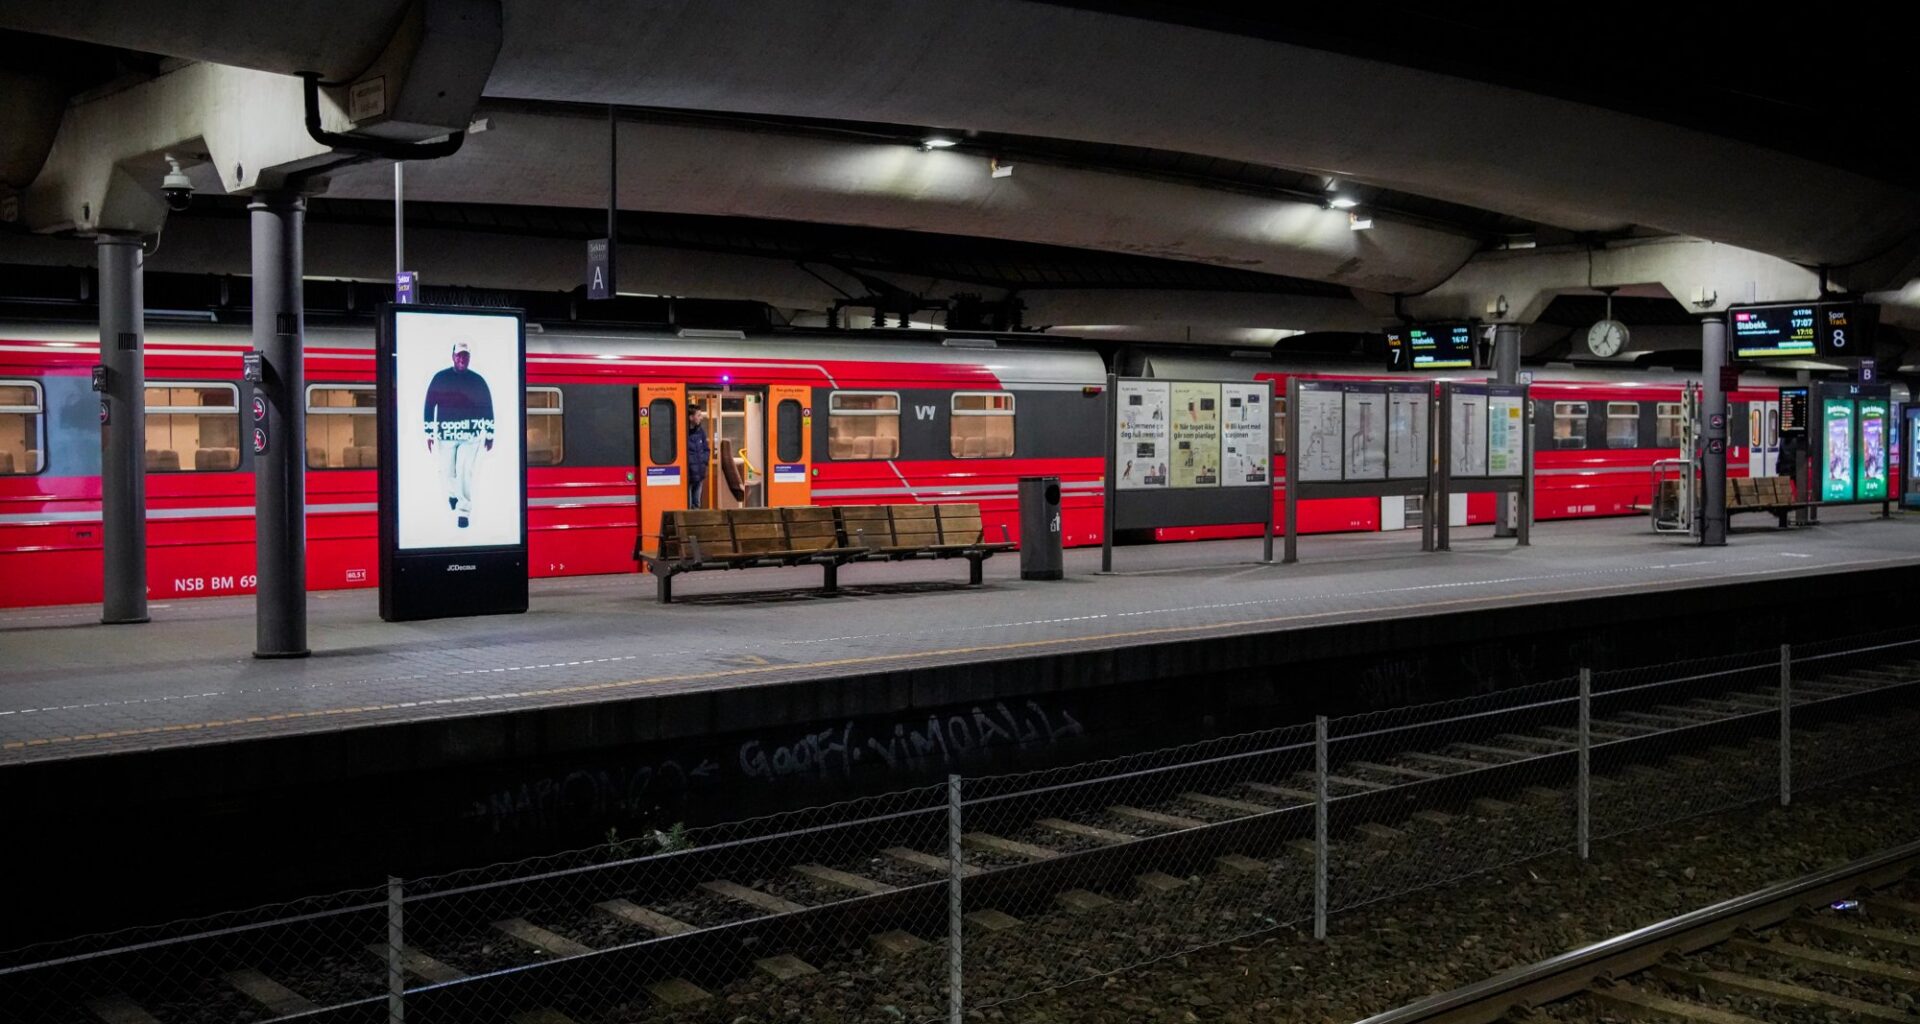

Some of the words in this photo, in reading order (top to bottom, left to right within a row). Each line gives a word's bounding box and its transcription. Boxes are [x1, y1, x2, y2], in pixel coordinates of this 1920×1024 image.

[592, 266, 604, 290] A
[1828, 311, 1844, 320] Spor
[1737, 321, 1767, 330] Stabekk
[1791, 318, 1813, 327] 17:07
[1833, 329, 1845, 348] 8
[1392, 349, 1400, 364] 7
[1864, 368, 1872, 381] B
[1194, 432, 1216, 440] planlagt
[175, 577, 204, 592] NSB
[211, 572, 234, 590] BM
[240, 575, 257, 588] 69
